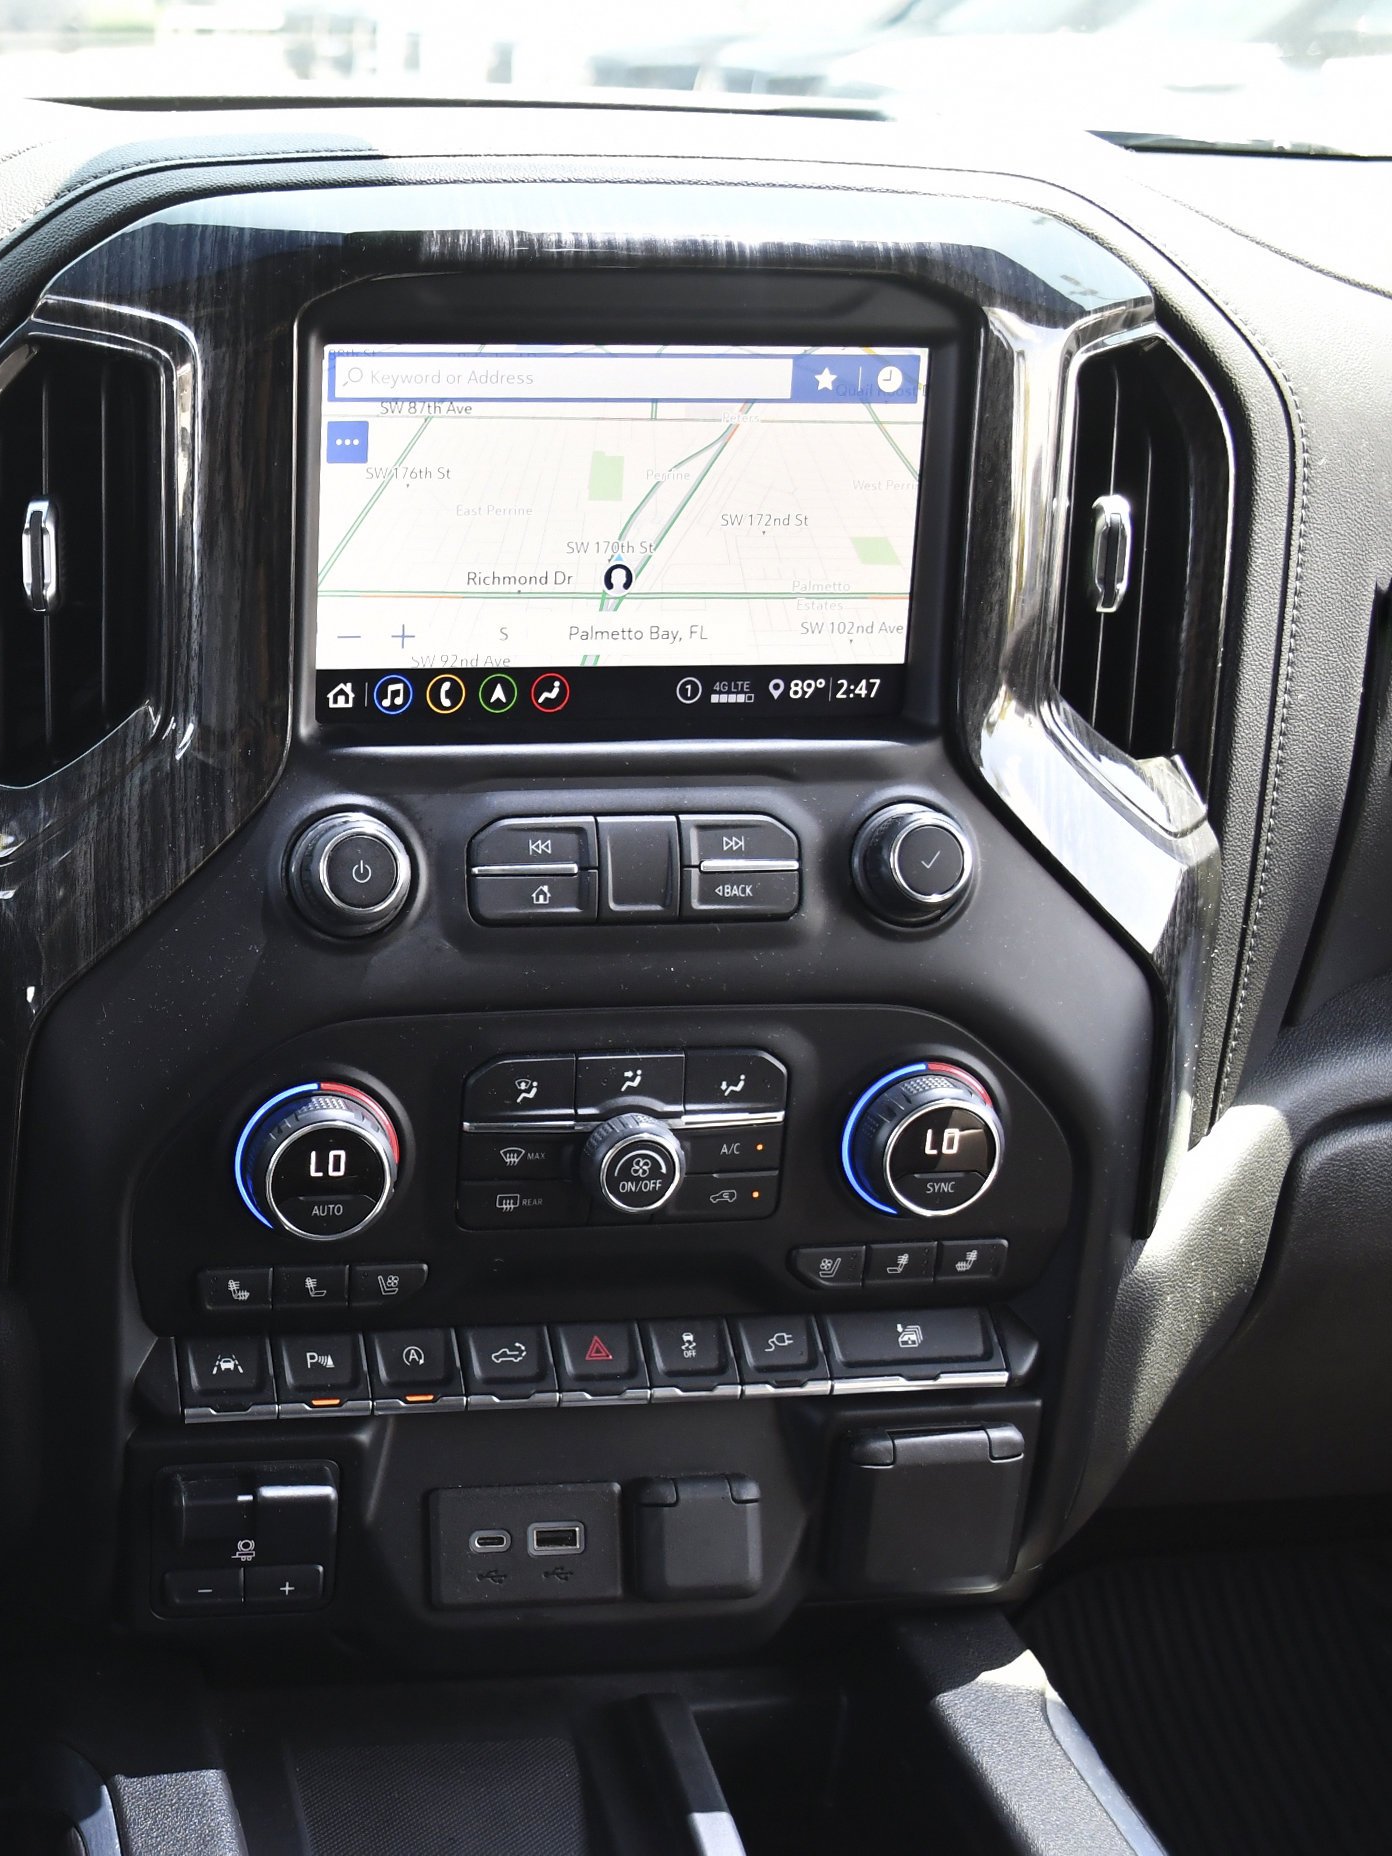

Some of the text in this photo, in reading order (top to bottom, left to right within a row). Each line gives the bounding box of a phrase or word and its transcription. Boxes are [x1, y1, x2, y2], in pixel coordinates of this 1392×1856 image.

[371, 370, 534, 389] Keyword or Address
[380, 401, 473, 415] SW 87th Ave
[365, 466, 451, 480] SW 176th St
[721, 513, 809, 527] SW 172nd St
[566, 542, 654, 554] SW 170th St
[467, 571, 573, 586] Richmond Dr
[792, 580, 850, 592] Palmetto
[797, 600, 843, 611] Estates
[500, 627, 509, 641] S
[568, 625, 708, 645] Palmetto Bay, FL
[800, 622, 904, 635] SW 102nd Ave
[440, 654, 478, 667] 92nd
[484, 655, 511, 667] Ave
[713, 681, 751, 692] 4G LTE
[789, 678, 826, 699] 89°
[835, 679, 881, 699] 2:47
[724, 885, 753, 897] BACK
[925, 1128, 960, 1155] LO
[720, 1143, 741, 1156] A/C
[526, 1152, 546, 1161] MAX
[310, 1150, 346, 1177] LO
[619, 1180, 663, 1194] ON/OFF
[926, 1181, 956, 1194] SYNC
[522, 1197, 543, 1207] REAR
[311, 1204, 343, 1217] AUTO
[683, 1350, 696, 1358] OFF
